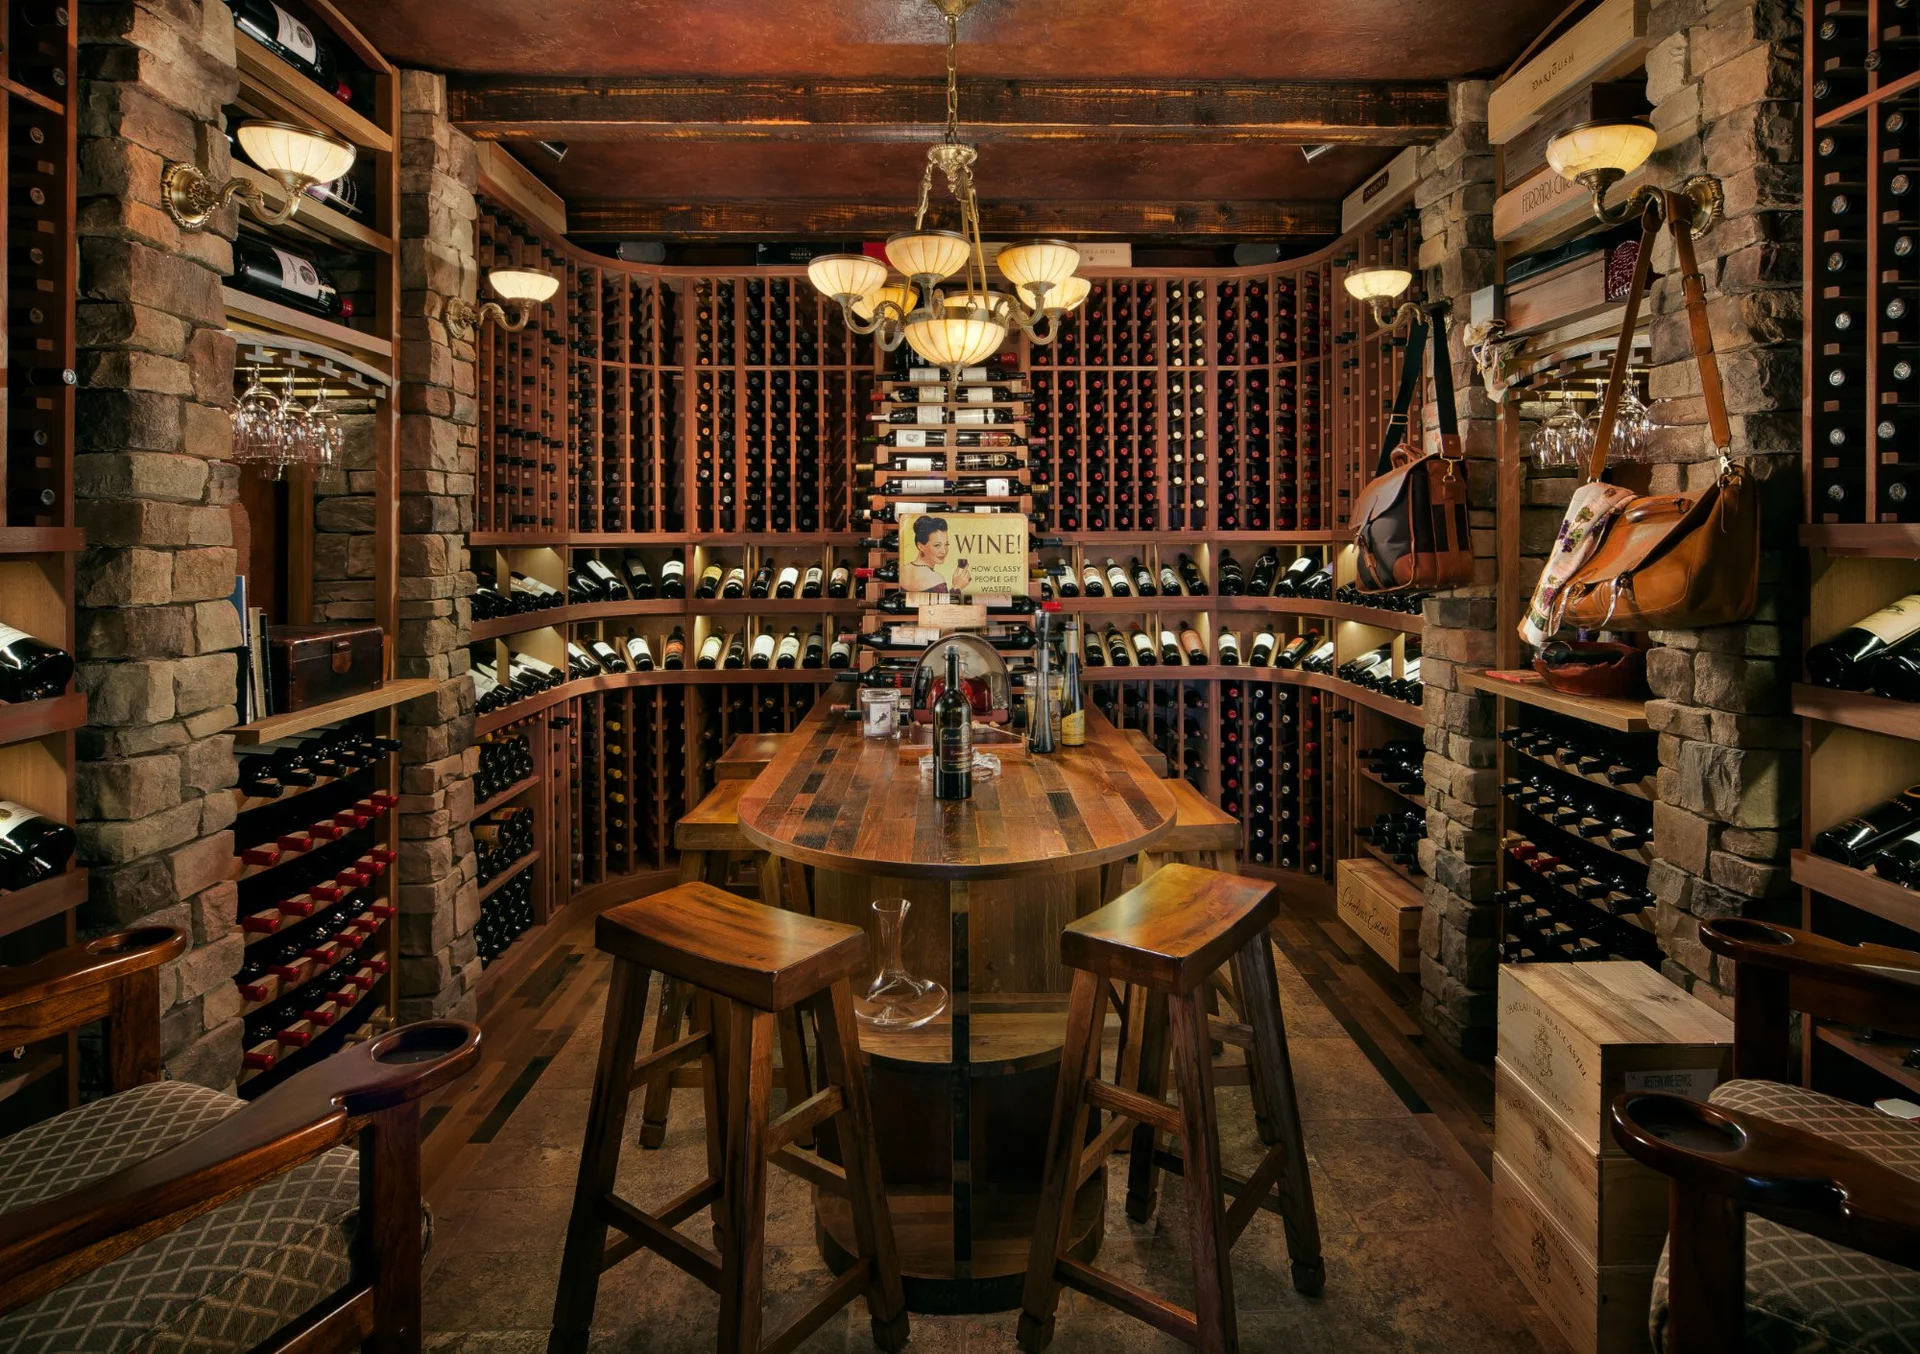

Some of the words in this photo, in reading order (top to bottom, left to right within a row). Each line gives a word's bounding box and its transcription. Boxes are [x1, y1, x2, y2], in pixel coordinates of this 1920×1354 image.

[954, 534, 1021, 555] WINE!
[1533, 1007, 1542, 1019] DE
[1545, 1015, 1587, 1078] BEAUCASTEL
